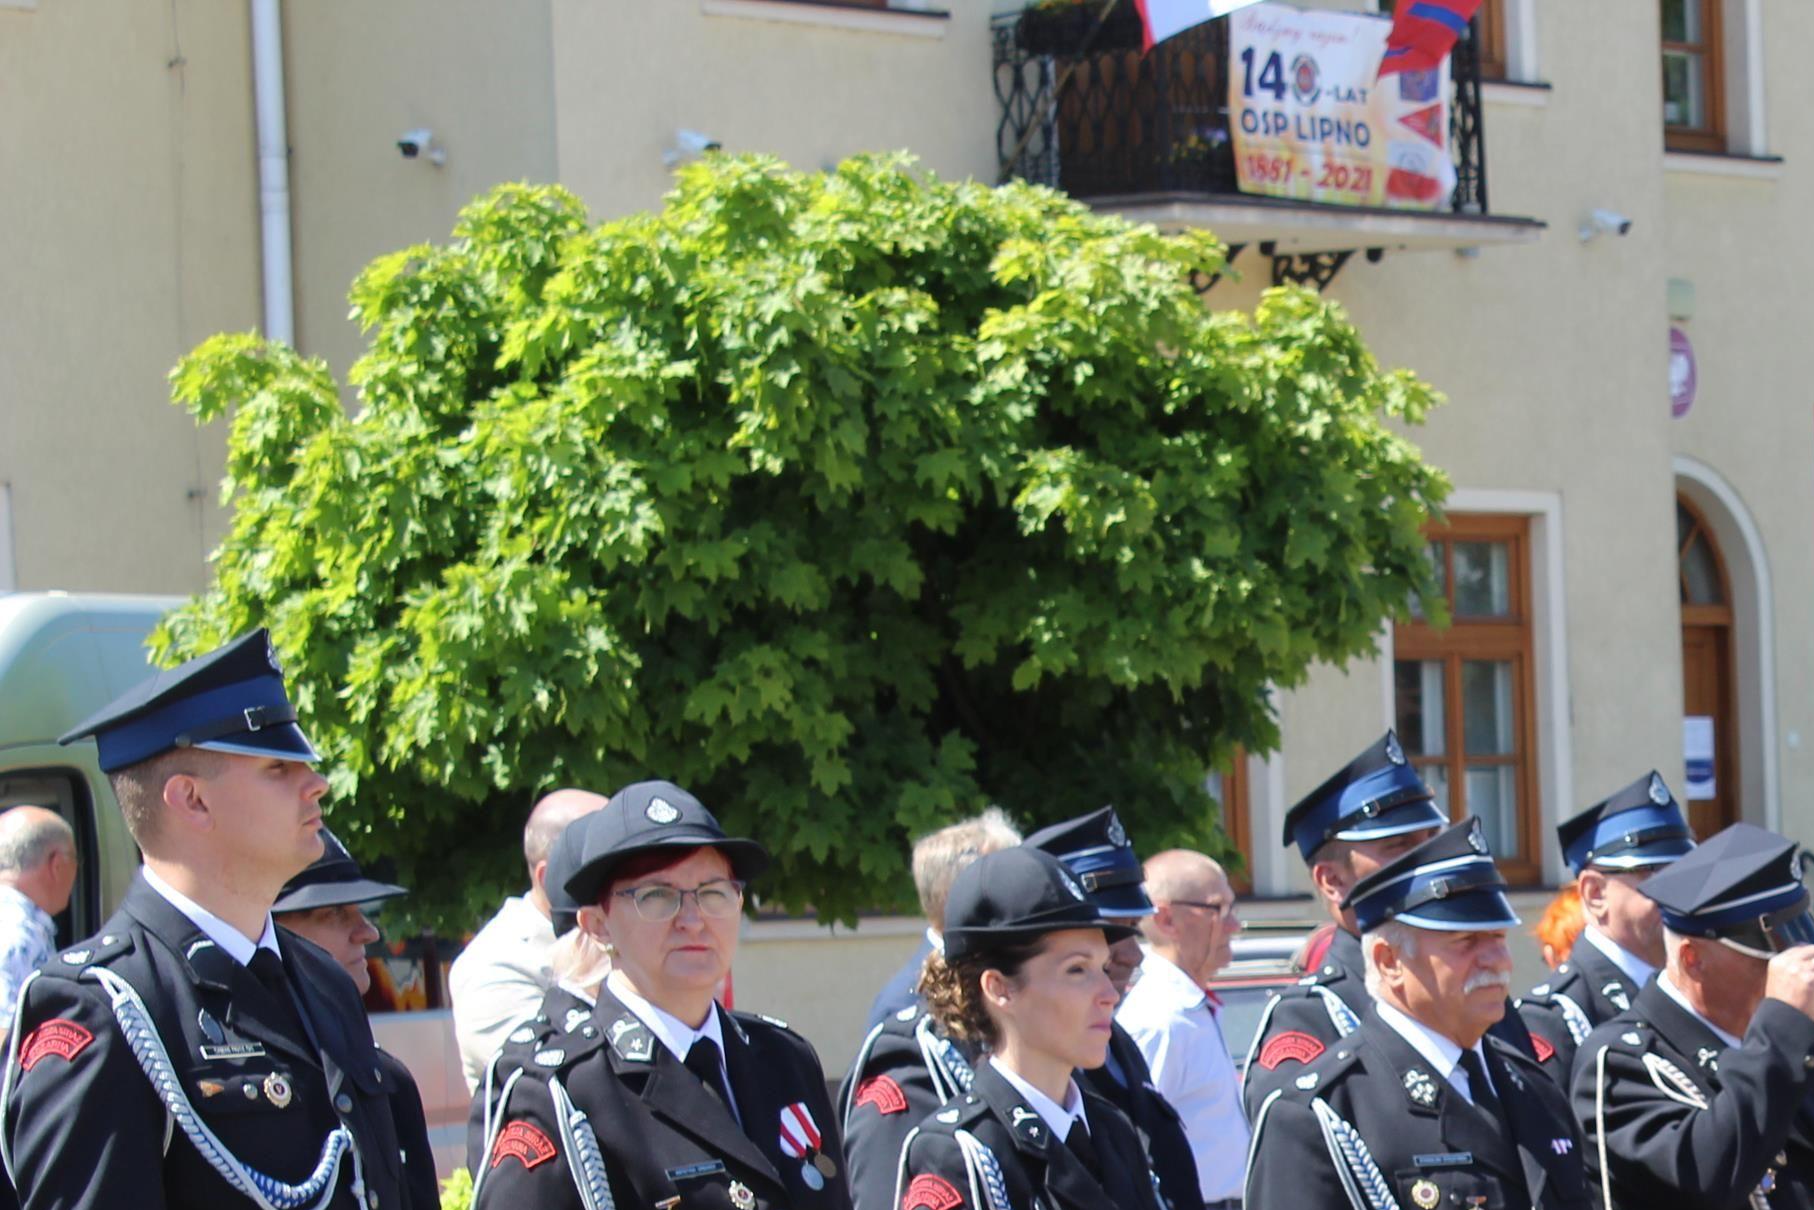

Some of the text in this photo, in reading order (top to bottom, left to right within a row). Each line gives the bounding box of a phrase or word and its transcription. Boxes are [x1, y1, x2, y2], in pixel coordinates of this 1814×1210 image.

[1241, 108, 1371, 149] OSP LIPNO
[1248, 154, 1294, 184] 1881
[1315, 161, 1373, 192] 2021
